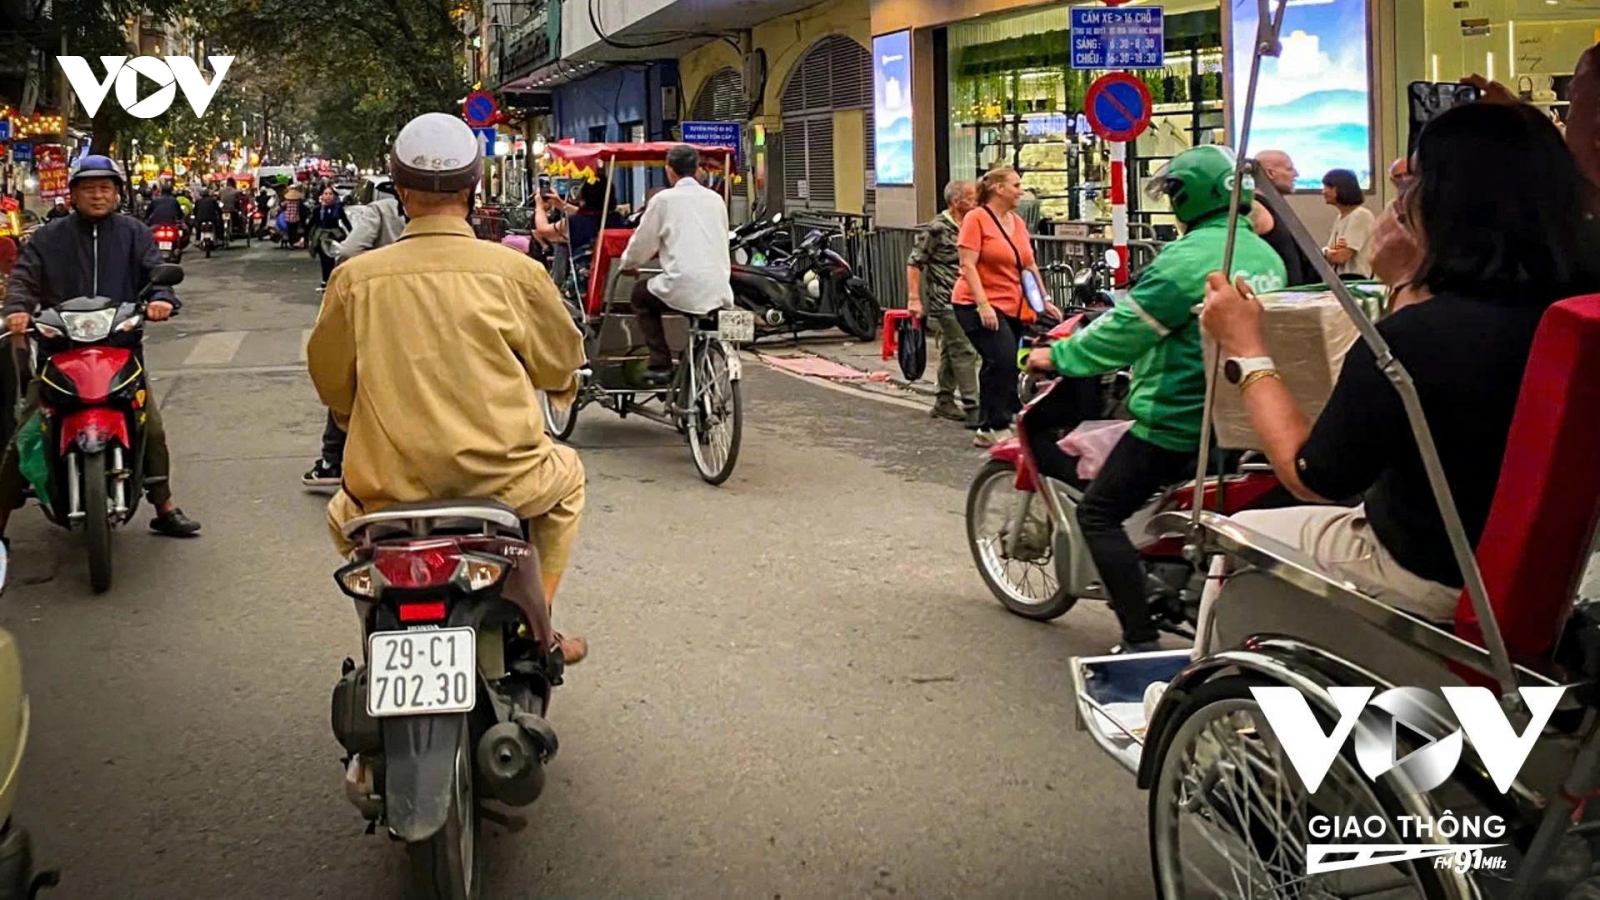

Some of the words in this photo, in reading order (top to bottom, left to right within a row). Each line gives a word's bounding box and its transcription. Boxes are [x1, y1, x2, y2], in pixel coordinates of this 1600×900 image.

[1081, 10, 1099, 23] CẤM
[1102, 13, 1113, 23] XE
[1124, 13, 1133, 23] 16
[385, 635, 456, 671] 29-C1
[376, 672, 467, 709] 702.30
